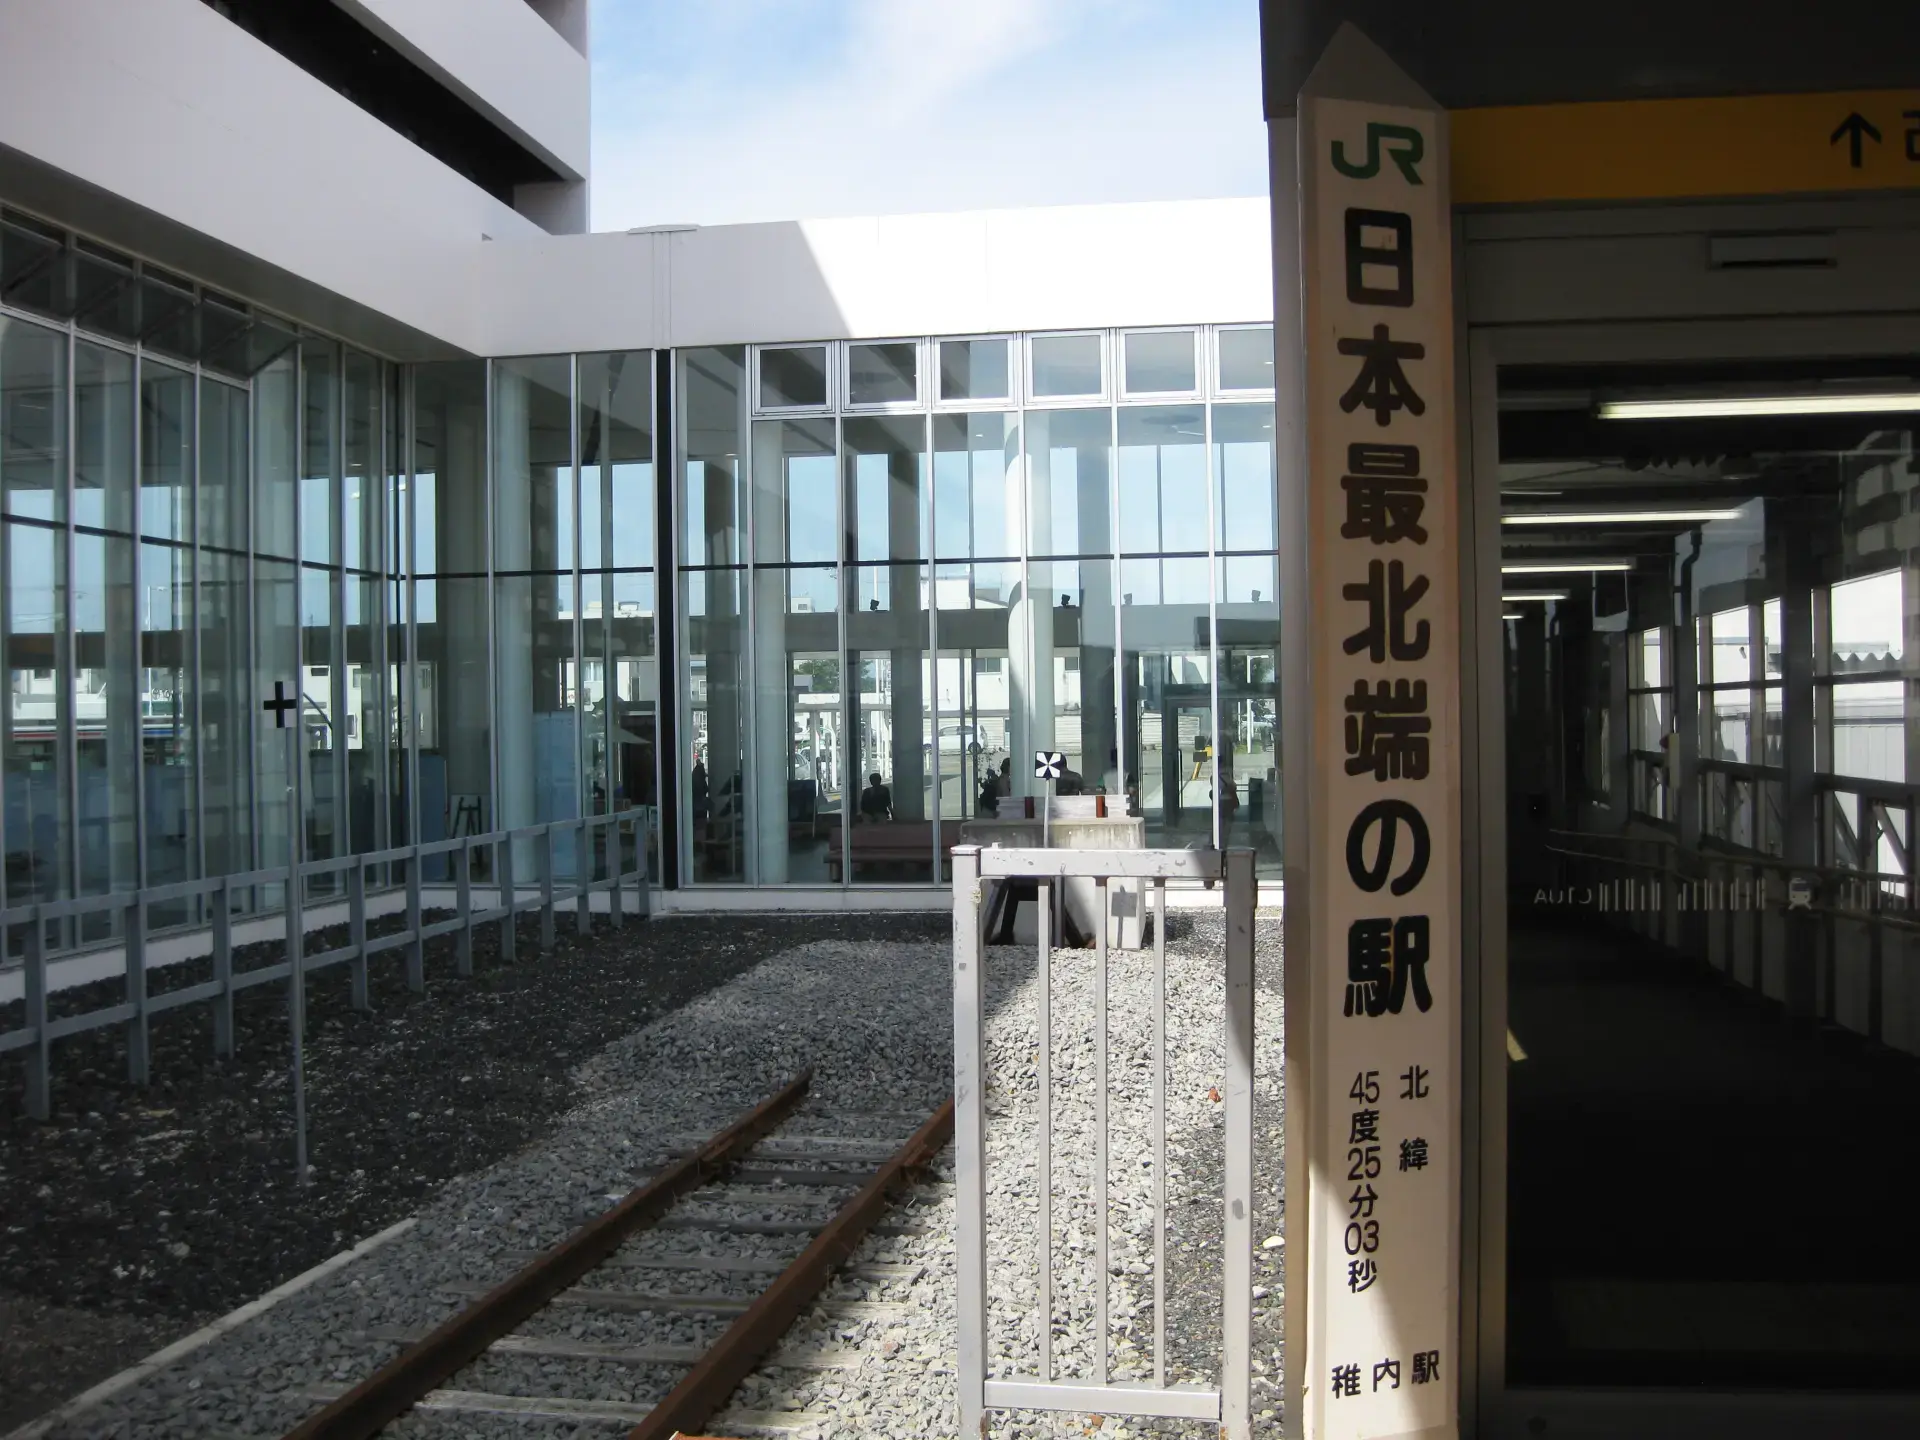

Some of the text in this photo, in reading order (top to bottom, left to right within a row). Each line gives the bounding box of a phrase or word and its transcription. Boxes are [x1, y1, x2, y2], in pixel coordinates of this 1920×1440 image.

[1331, 122, 1424, 185] JR
[1337, 207, 1432, 1017] 日本最北端の駅
[1399, 1065, 1429, 1172] 北緯
[1344, 1070, 1381, 1294] 45度25分03秒
[1331, 1349, 1440, 1399] 稚内駅
